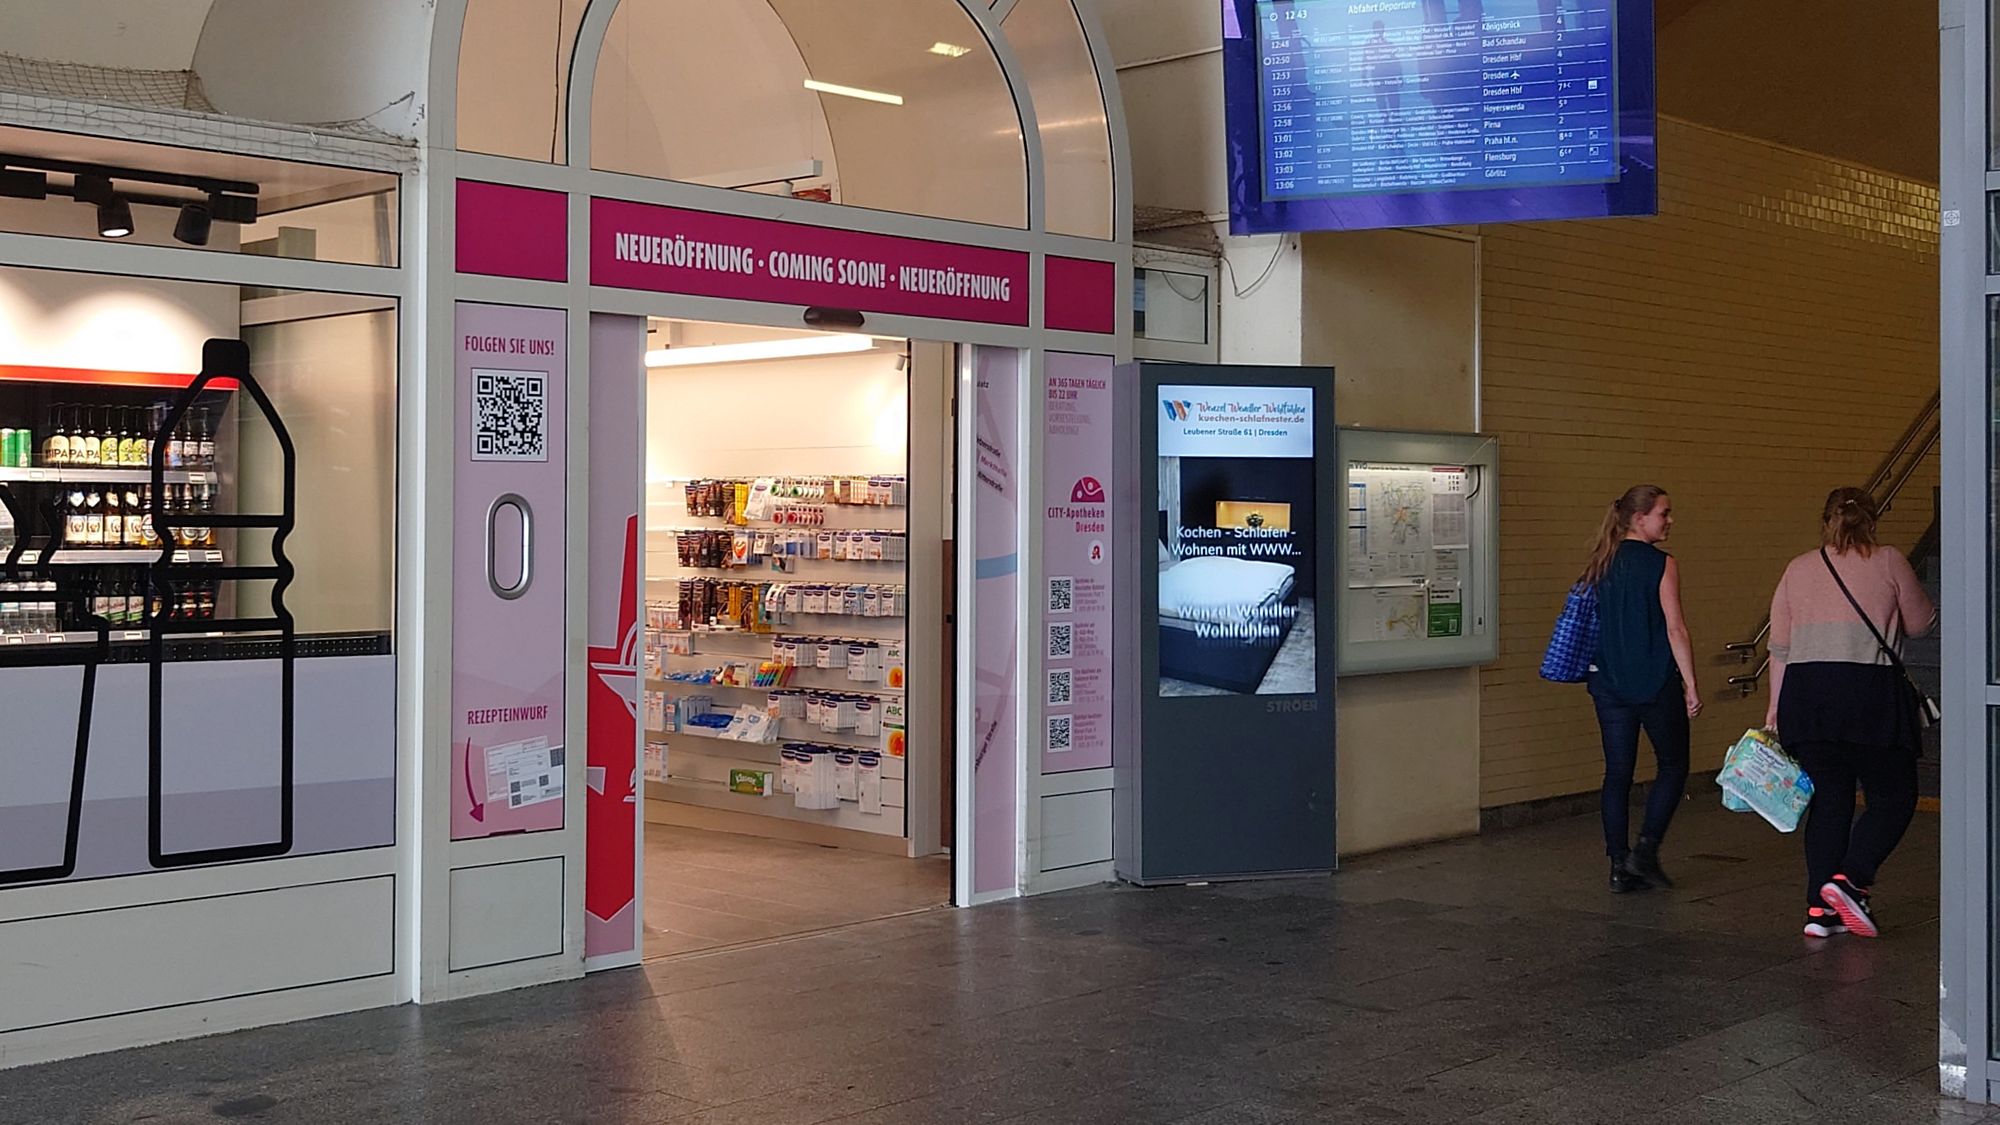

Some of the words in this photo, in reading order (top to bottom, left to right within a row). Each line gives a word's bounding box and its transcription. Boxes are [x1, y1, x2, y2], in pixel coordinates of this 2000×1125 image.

[1348, 4, 1378, 14] Abfahrt
[1380, 1, 1416, 13] Departure
[1482, 20, 1520, 31] Königsbrück
[1482, 39, 1494, 47] Bad
[1495, 38, 1526, 46] Schandau
[1272, 56, 1290, 65] 12:50
[1482, 55, 1508, 64] Dresden
[1509, 53, 1522, 61] Hbf
[1272, 72, 1290, 80] 12:53
[1483, 72, 1509, 80] Dresden
[1272, 88, 1291, 96] 12:55
[1483, 88, 1509, 97] Dresden
[1510, 86, 1523, 95] Hbf
[1273, 103, 1291, 112] 12:56
[1483, 103, 1525, 113] Hoyerswerda
[1274, 134, 1292, 143] 13:01
[1484, 137, 1503, 145] Praha
[1274, 150, 1293, 159] 13:02
[1485, 153, 1517, 161] Flensburg
[1275, 166, 1293, 174] 13:03
[1485, 169, 1507, 177] Görlitz
[1276, 181, 1294, 190] 13:06
[615, 232, 753, 275] NEUERÖFFNUNG
[769, 251, 833, 283] COMING
[837, 259, 886, 289] SOON!
[899, 266, 1010, 302] NEUERÖFFNUNG
[465, 335, 506, 353] FOLGEN
[509, 338, 526, 354] SIE
[529, 339, 554, 356] UNS!
[1049, 378, 1057, 387] AN
[1058, 378, 1068, 387] 365
[1069, 378, 1085, 388] TAGEN
[1086, 378, 1106, 389] TÄGLICH
[1048, 389, 1057, 399] BIS
[1058, 389, 1066, 400] 22
[1066, 390, 1078, 400] UHR
[1196, 401, 1227, 413] Wenzel
[1228, 401, 1262, 413] Wendler
[1198, 414, 1305, 423] kuechen-schlafnester.de
[1183, 428, 1216, 436] Leubener
[1217, 428, 1242, 436] Straße
[1258, 429, 1288, 437] Dresden
[1048, 507, 1104, 520] CITY-Apotheken
[1076, 521, 1104, 533] Dresden
[1176, 526, 1222, 538] Kochen
[1234, 526, 1287, 538] Schlafen
[1171, 543, 1223, 556] Wohnen
[1226, 543, 1247, 556] mit
[1249, 543, 1302, 556] WWW...
[1178, 604, 1230, 618] Wenzel
[1236, 603, 1297, 619] Wendler
[1266, 697, 1318, 713] STRÖER
[467, 705, 548, 725] REZEPTEINWURF
[886, 706, 902, 716] ABC
